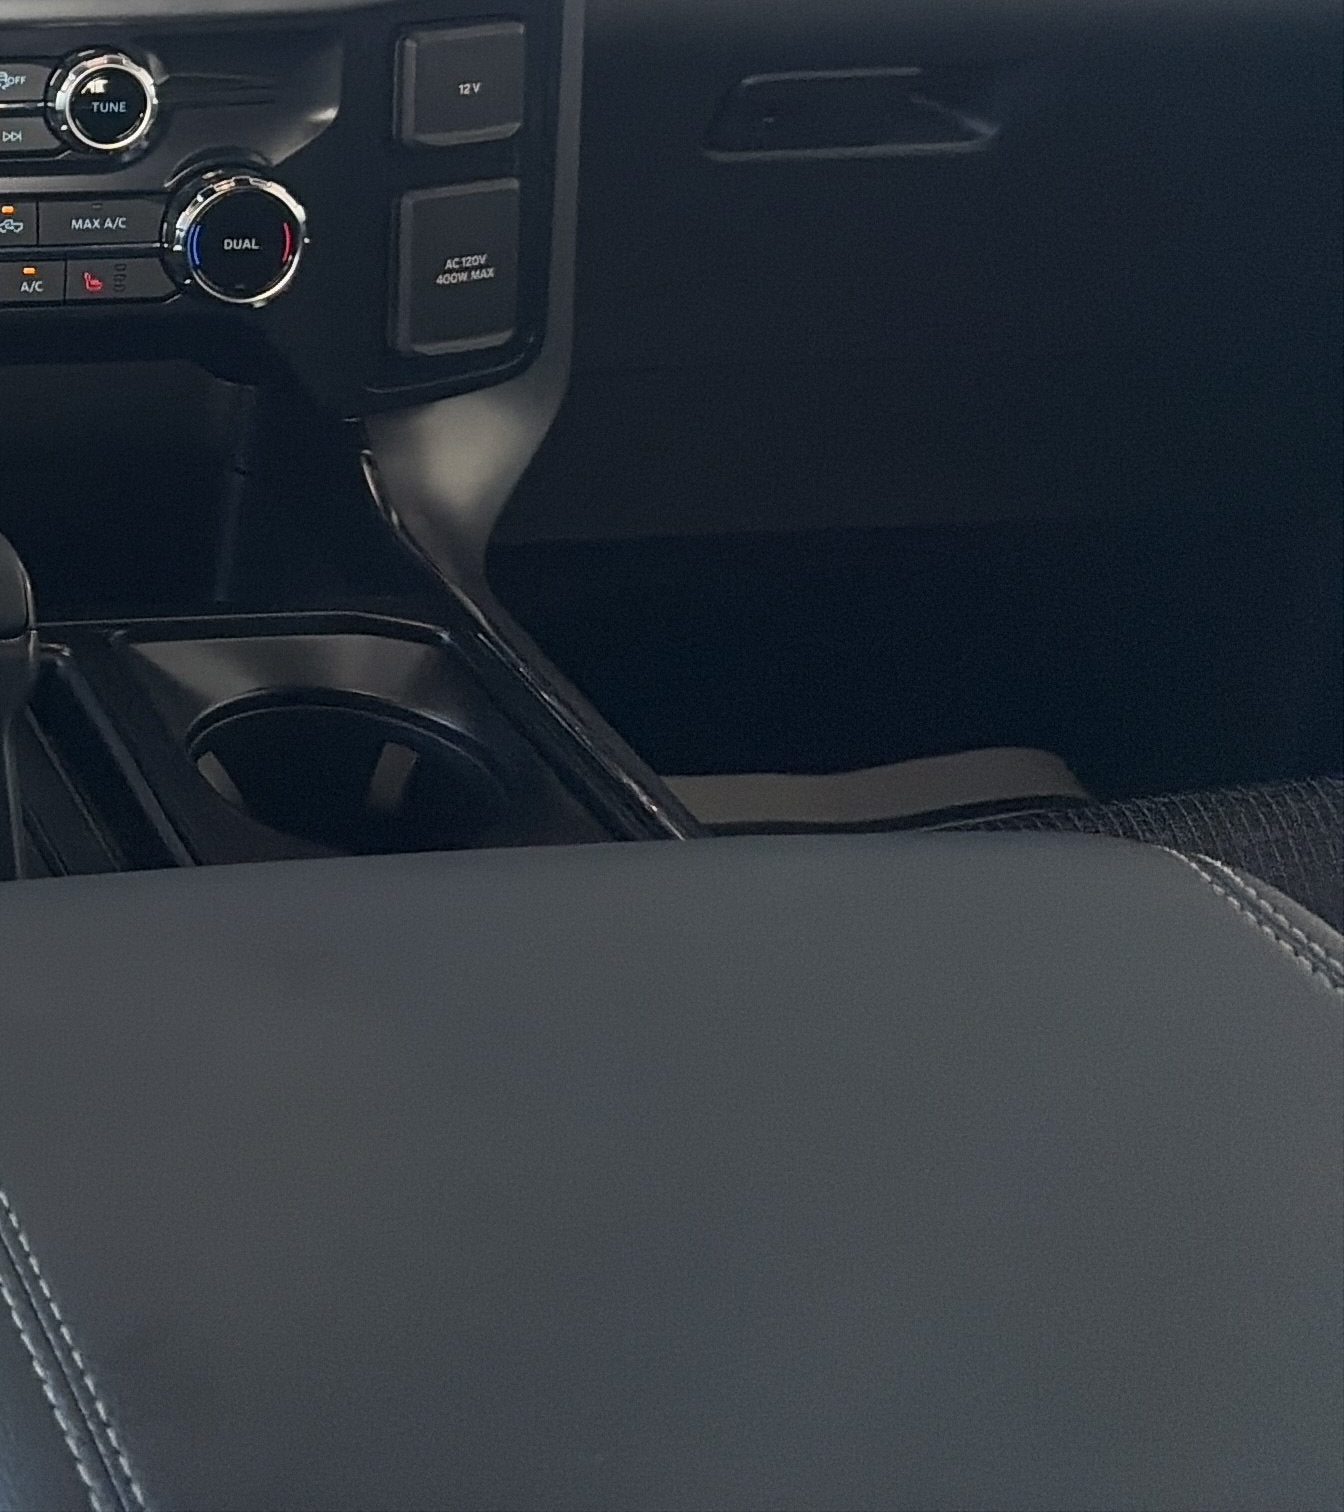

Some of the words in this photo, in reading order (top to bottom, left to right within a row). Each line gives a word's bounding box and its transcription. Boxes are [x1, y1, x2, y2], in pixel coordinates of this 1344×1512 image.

[7, 75, 26, 85] OFF
[92, 101, 127, 113] TUNE
[72, 218, 100, 230] MAX
[103, 216, 127, 230] A/C
[223, 238, 260, 251] DUAL
[436, 271, 469, 285] 400W
[470, 267, 495, 280] MAX
[20, 280, 44, 293] A/C
